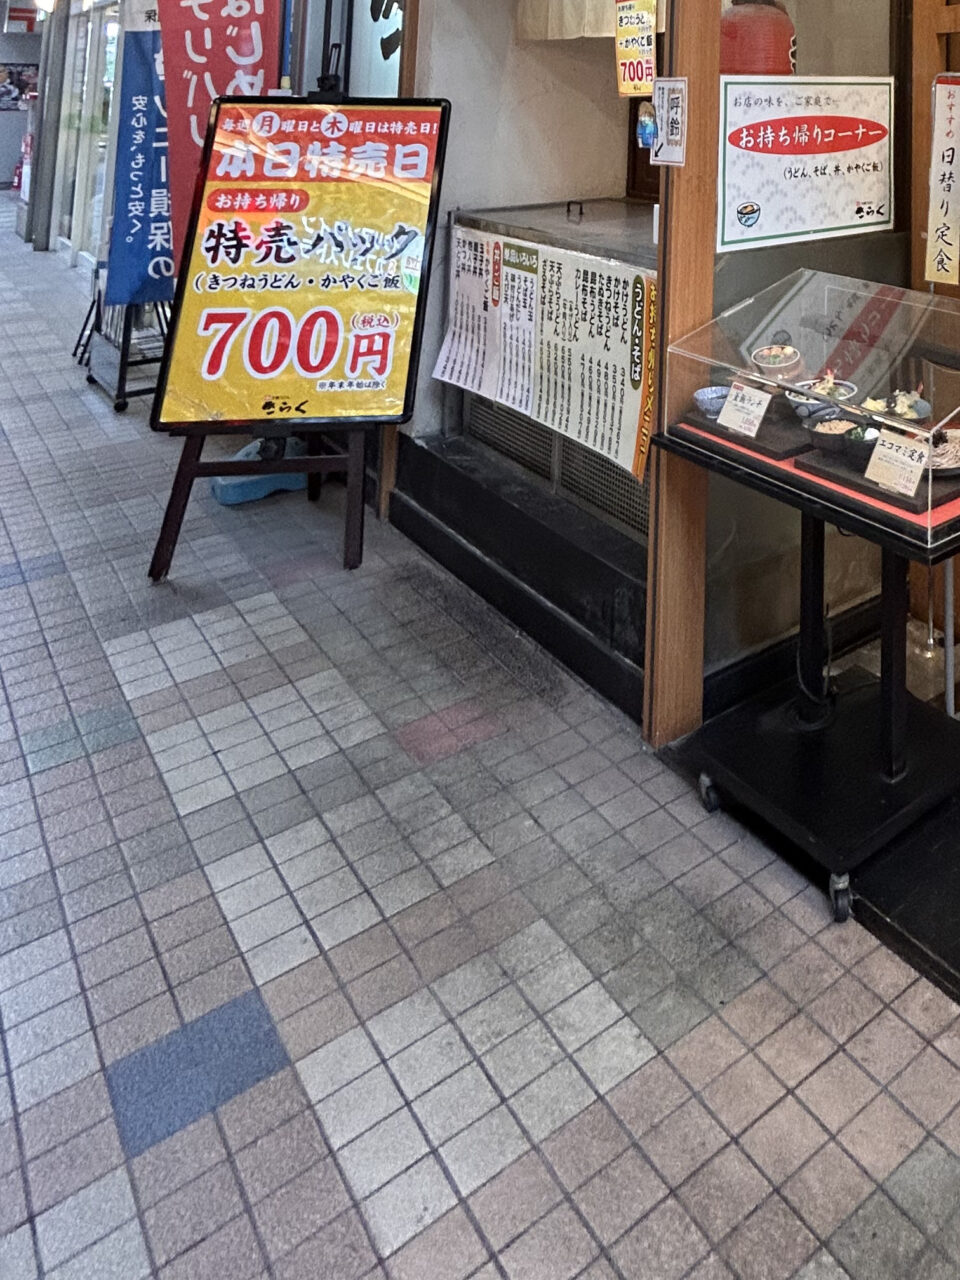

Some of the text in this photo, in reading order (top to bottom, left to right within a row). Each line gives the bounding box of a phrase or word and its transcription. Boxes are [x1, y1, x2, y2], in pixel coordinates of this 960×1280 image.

[620, 60, 644, 82] 700
[739, 124, 882, 148] お持ち帰りコーナー
[216, 141, 428, 179] 本日特売日
[216, 192, 301, 210] お持ち帰り
[932, 147, 956, 273] 日替り定食
[204, 219, 418, 266] 特売パック
[202, 309, 340, 377] 700
[350, 331, 391, 377] 円
[631, 283, 643, 381] うどん・そば
[262, 400, 309, 415] きらく
